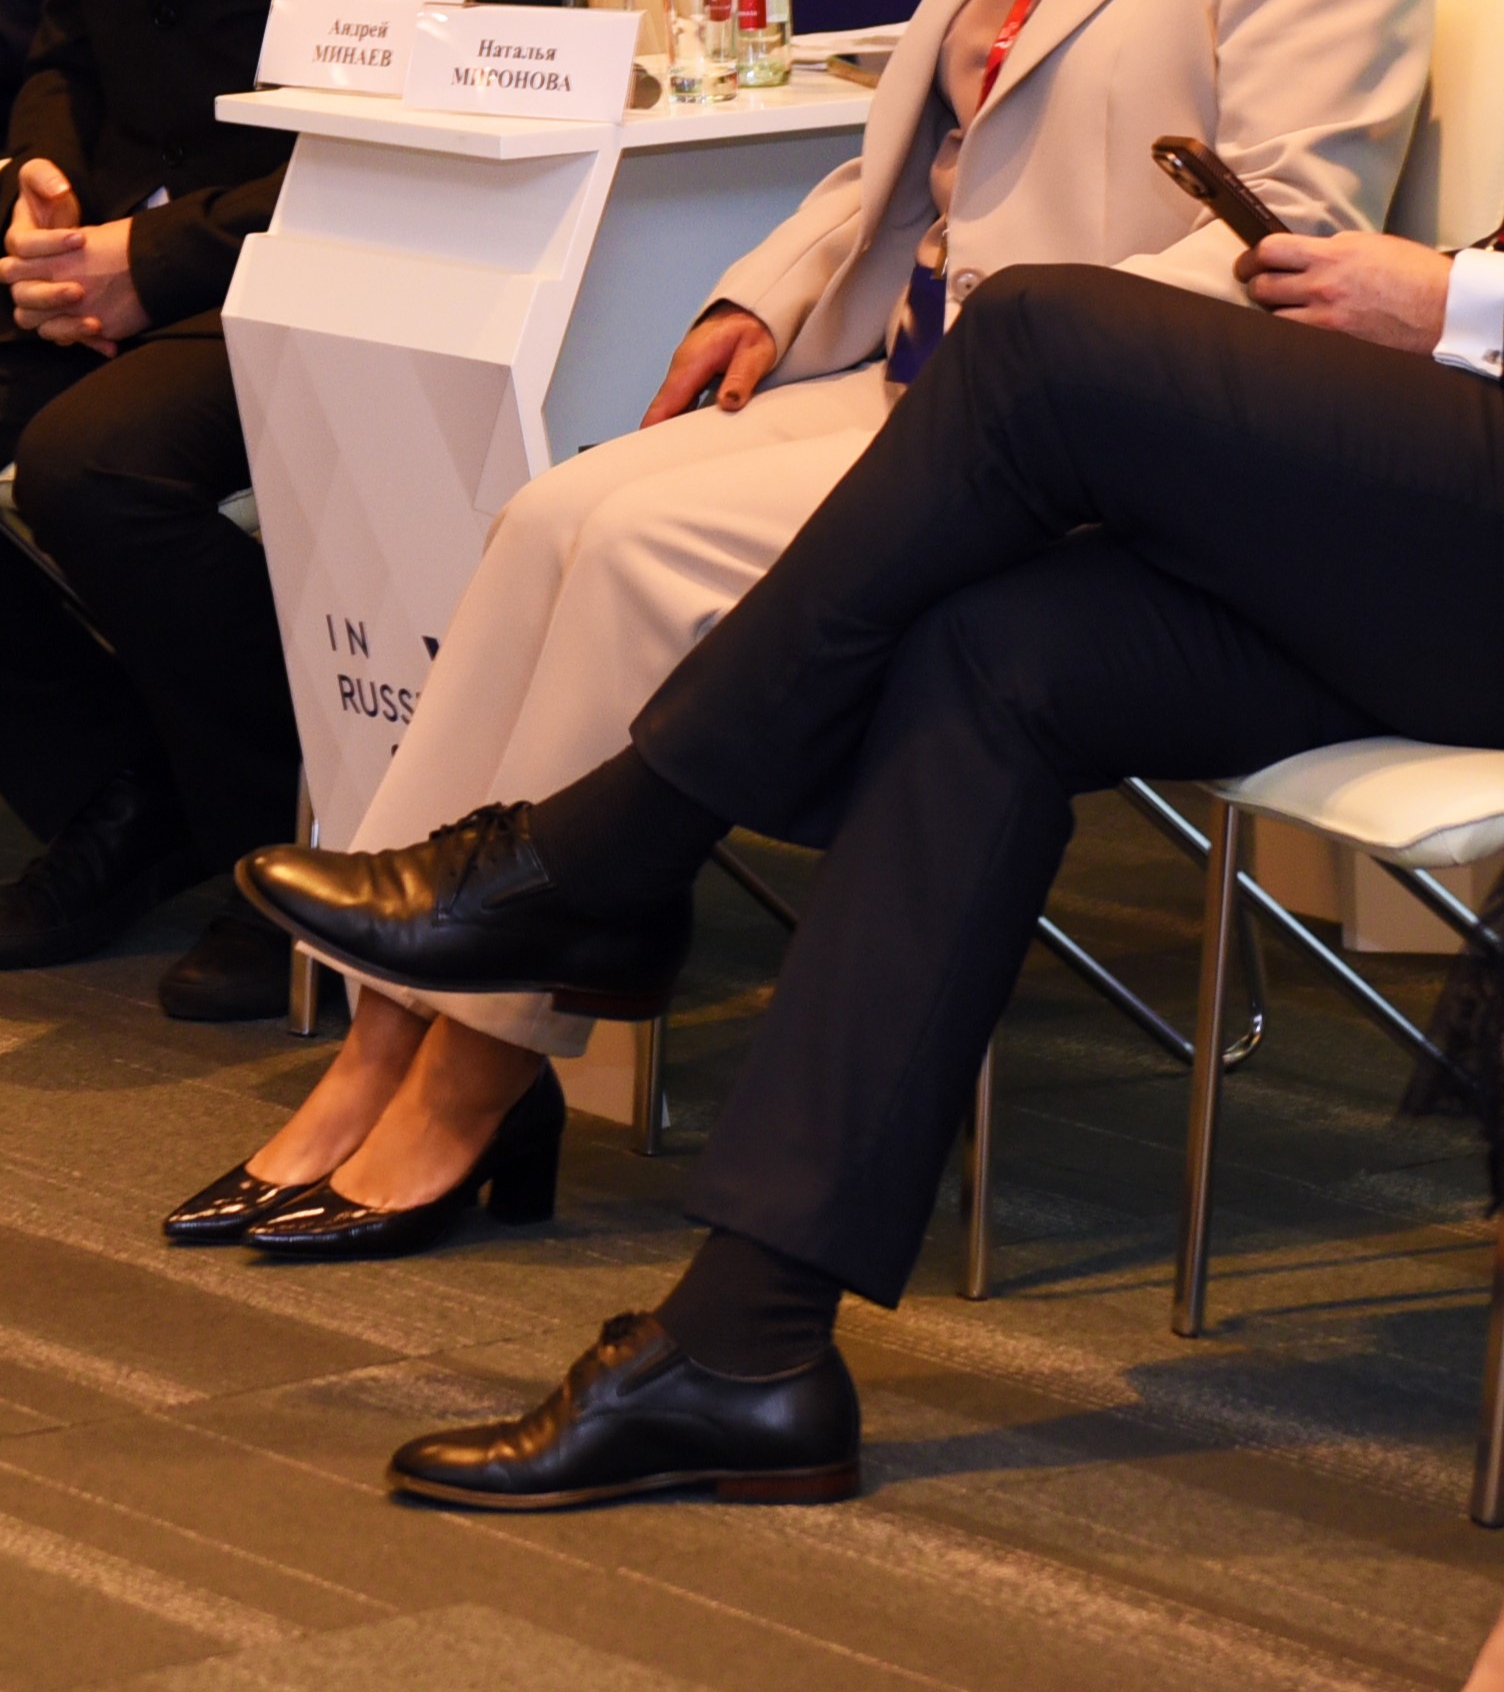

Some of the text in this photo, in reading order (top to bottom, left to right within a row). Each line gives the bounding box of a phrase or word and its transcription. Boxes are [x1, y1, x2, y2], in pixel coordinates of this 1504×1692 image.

[328, 18, 389, 40] Андрей
[312, 44, 393, 69] МИНАЕВ
[477, 38, 557, 63] Наталья
[325, 613, 370, 660] IN
[337, 673, 422, 726] RUSS
